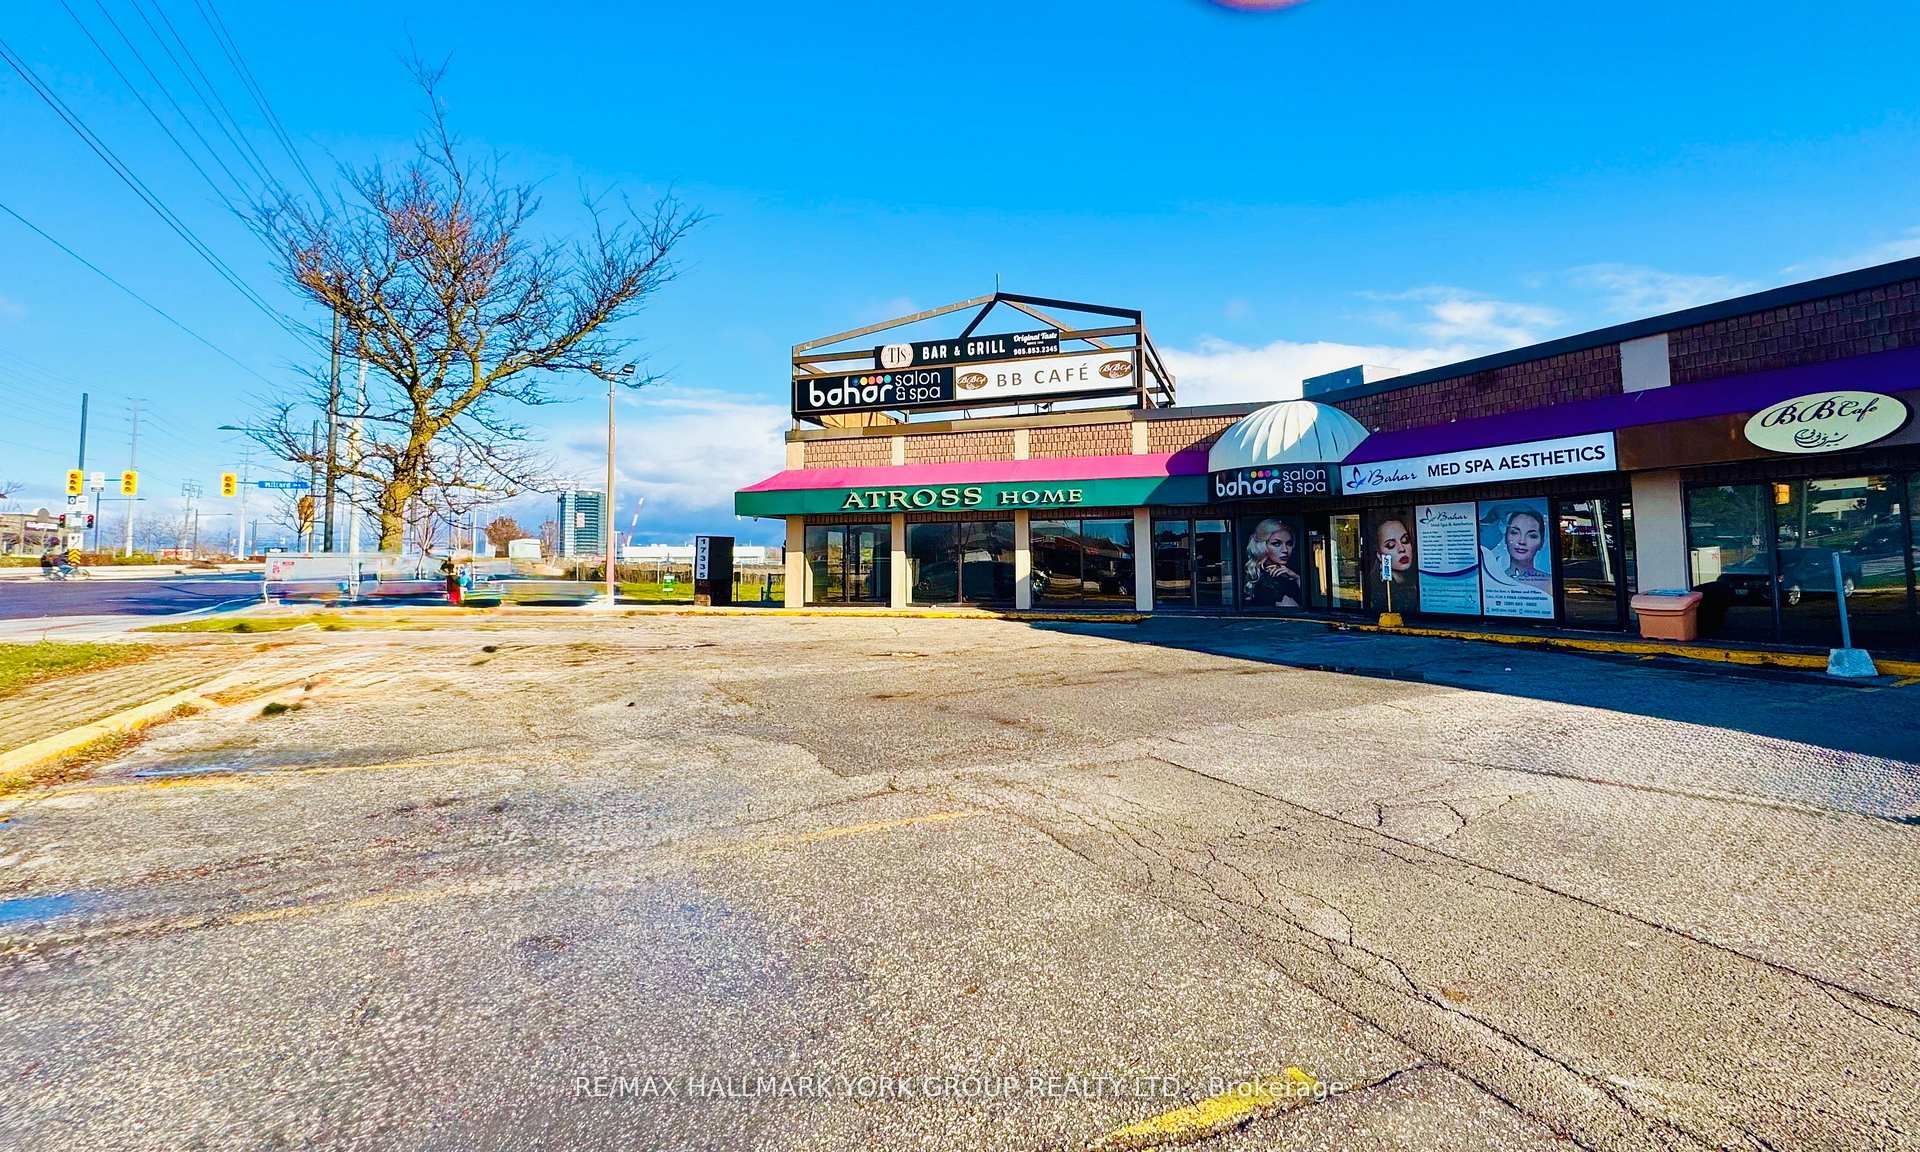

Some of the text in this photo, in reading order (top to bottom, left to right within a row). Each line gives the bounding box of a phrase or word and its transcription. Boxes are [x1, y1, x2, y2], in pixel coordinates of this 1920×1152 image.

[922, 346, 947, 360] BAR
[954, 347, 960, 357] &
[967, 340, 1006, 356] GRILL
[895, 371, 941, 387] salon
[997, 362, 1089, 387] BB CAFÉ
[809, 376, 893, 407] bahar
[896, 386, 941, 403] & spa
[1838, 397, 1880, 422] Cafe
[1282, 468, 1326, 481] salon
[1367, 445, 1606, 485] Bahar MED SPA AESTHETICS
[1216, 471, 1281, 497] bahar
[1283, 481, 1326, 495] & spa
[842, 487, 1083, 508] ATROSS HOME
[699, 538, 707, 578] 17335
